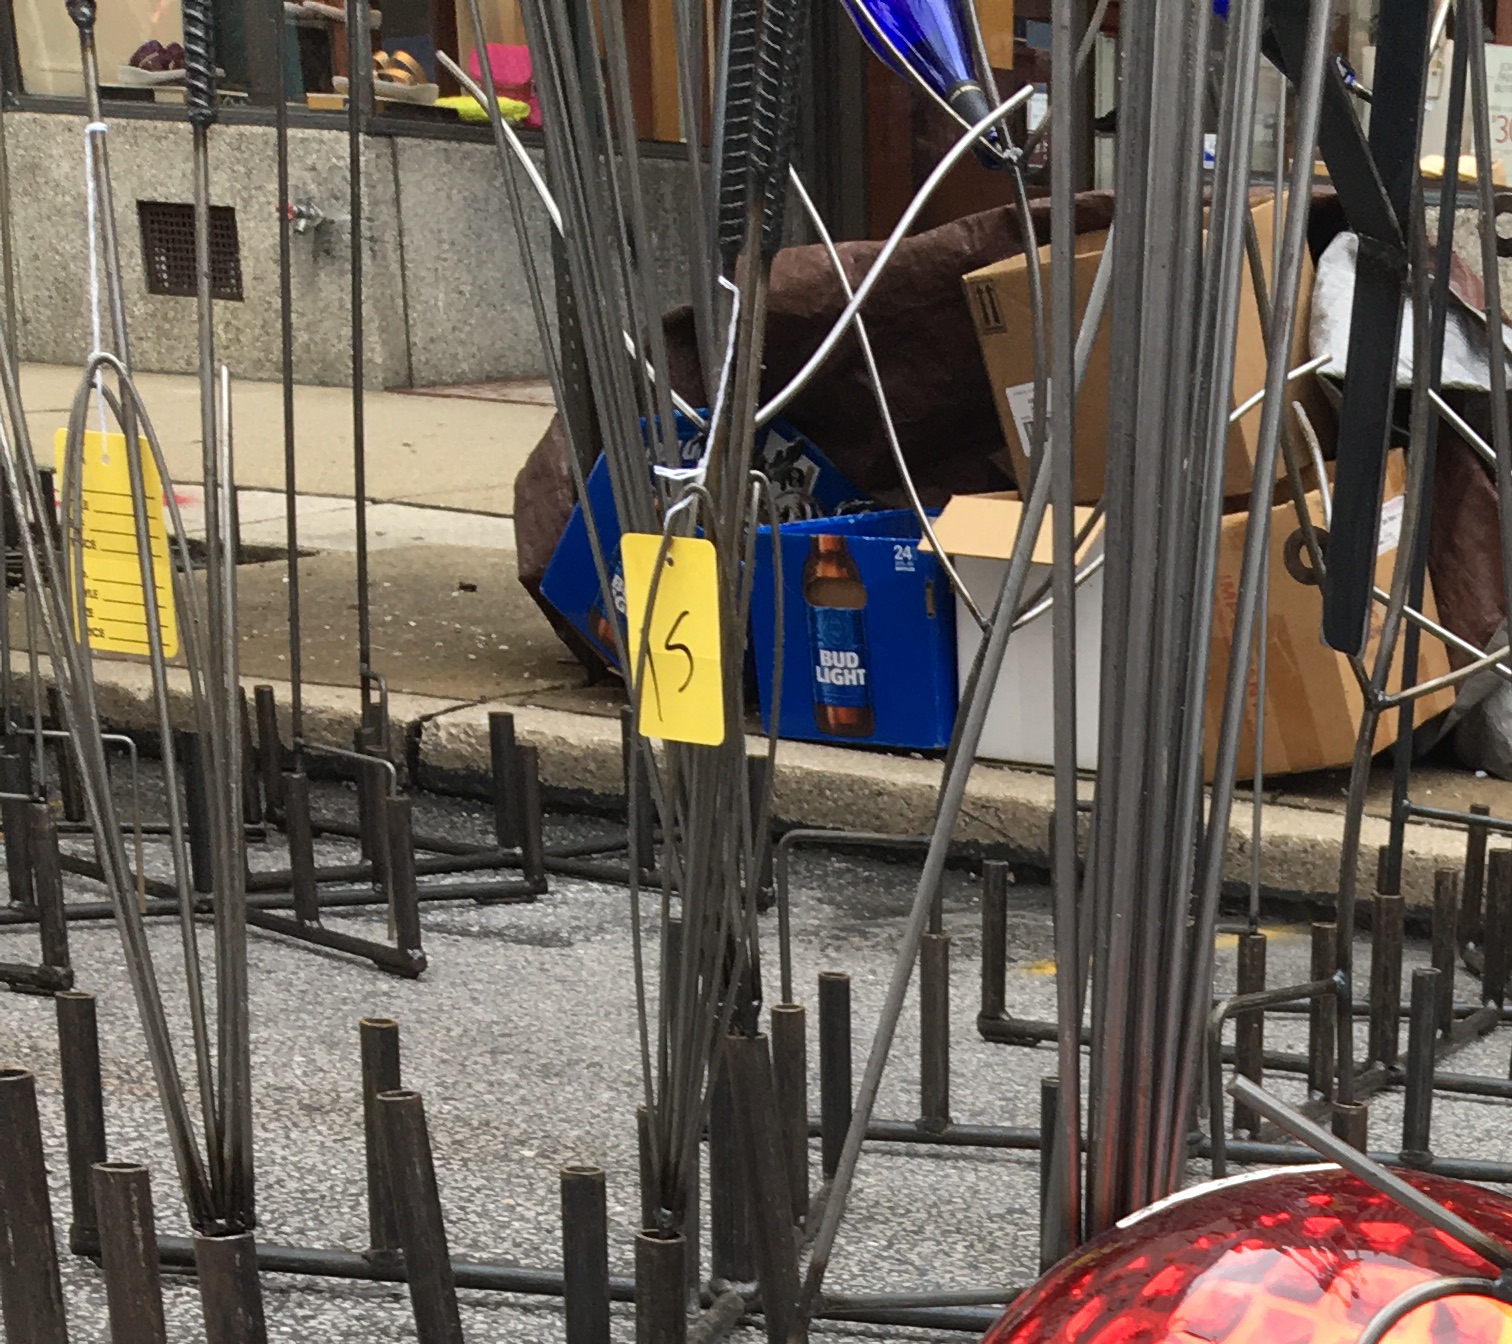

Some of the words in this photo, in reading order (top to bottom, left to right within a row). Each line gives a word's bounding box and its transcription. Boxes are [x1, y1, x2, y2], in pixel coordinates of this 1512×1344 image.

[894, 545, 912, 560] 24
[819, 650, 859, 668] BUD
[815, 666, 866, 685] LIGHT
